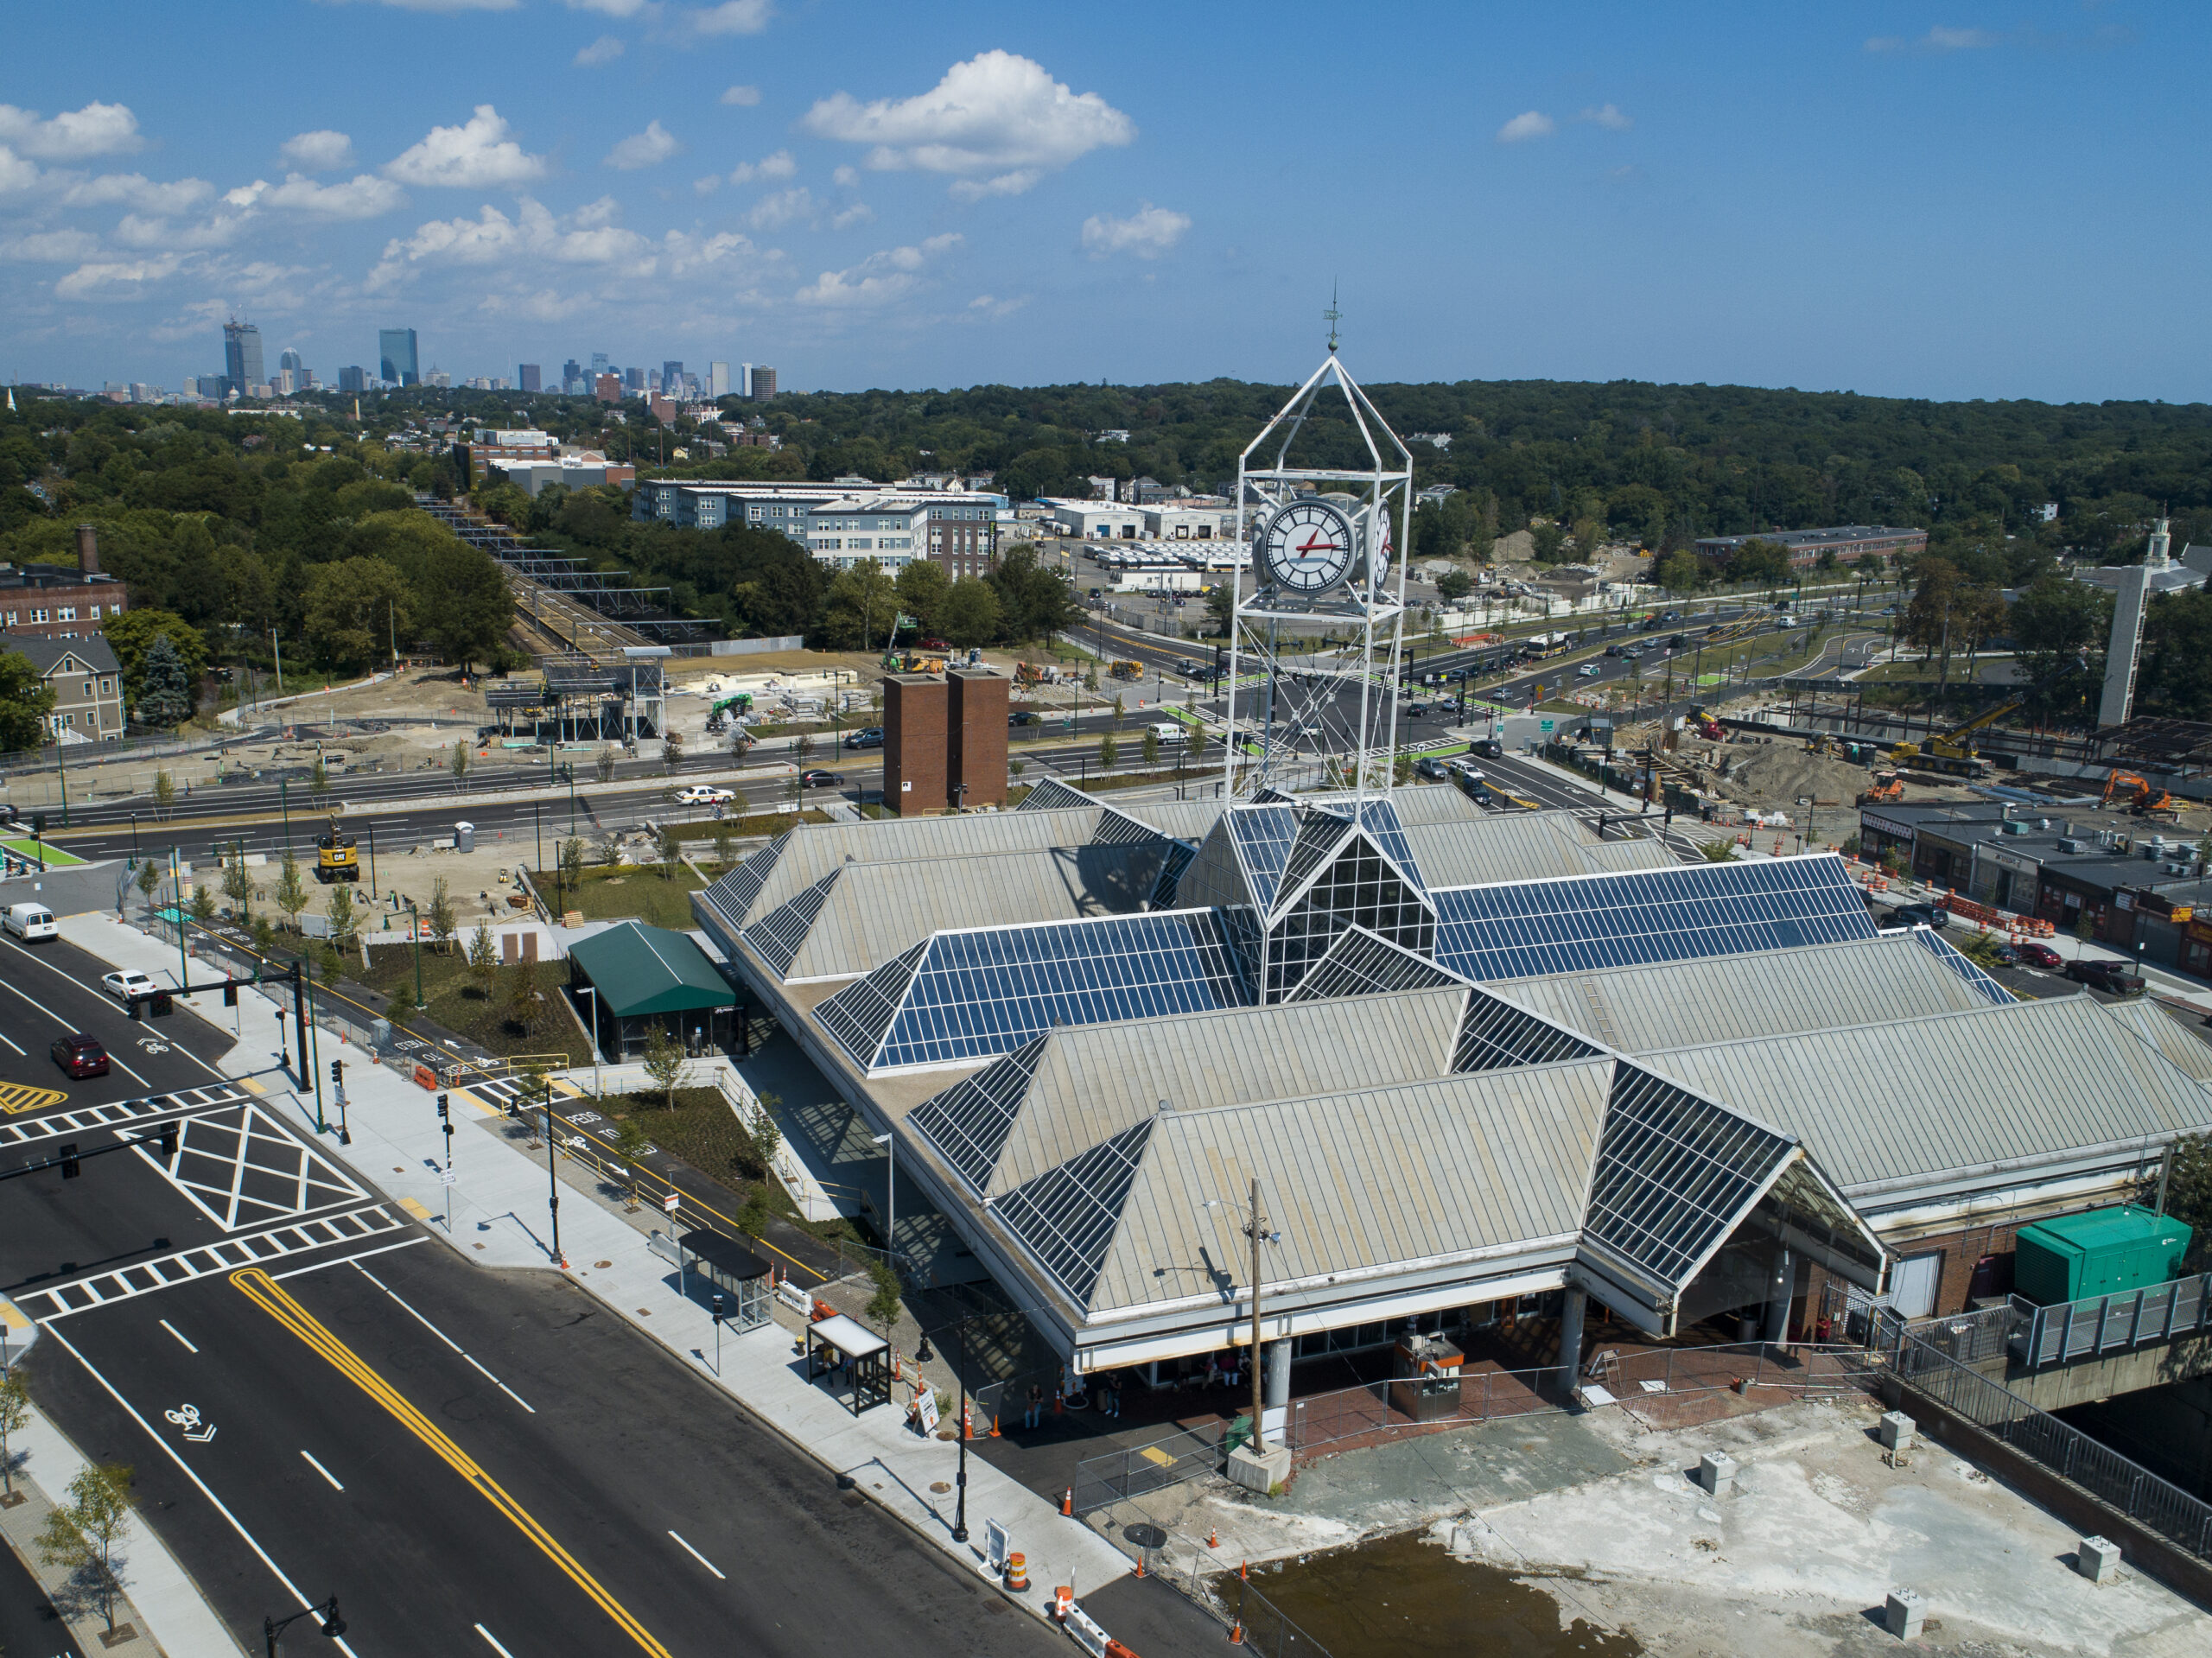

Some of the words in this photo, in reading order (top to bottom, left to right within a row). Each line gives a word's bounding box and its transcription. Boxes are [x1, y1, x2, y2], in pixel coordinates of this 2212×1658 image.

[334, 853, 346, 861] CAT
[212, 926, 240, 936] PEDS
[564, 1111, 602, 1126] PEDS
[597, 1128, 622, 1140] TO
